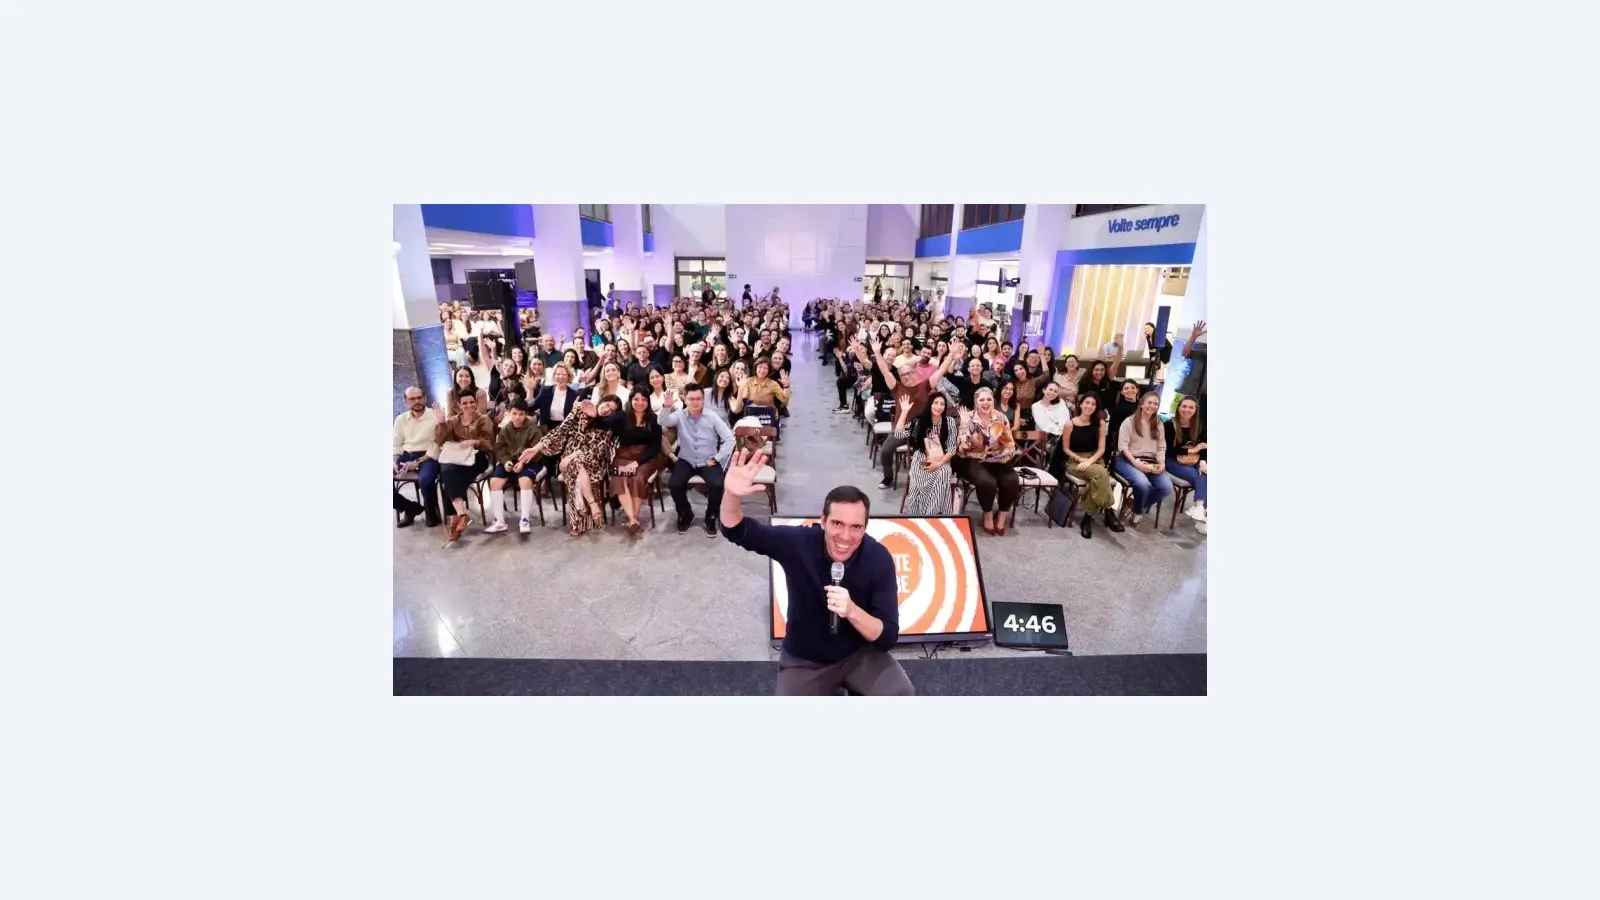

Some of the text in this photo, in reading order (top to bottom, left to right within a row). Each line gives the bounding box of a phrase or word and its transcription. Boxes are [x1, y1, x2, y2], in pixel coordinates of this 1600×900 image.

[1108, 214, 1180, 233] Volte sempre
[1003, 613, 1057, 634] 4:46
